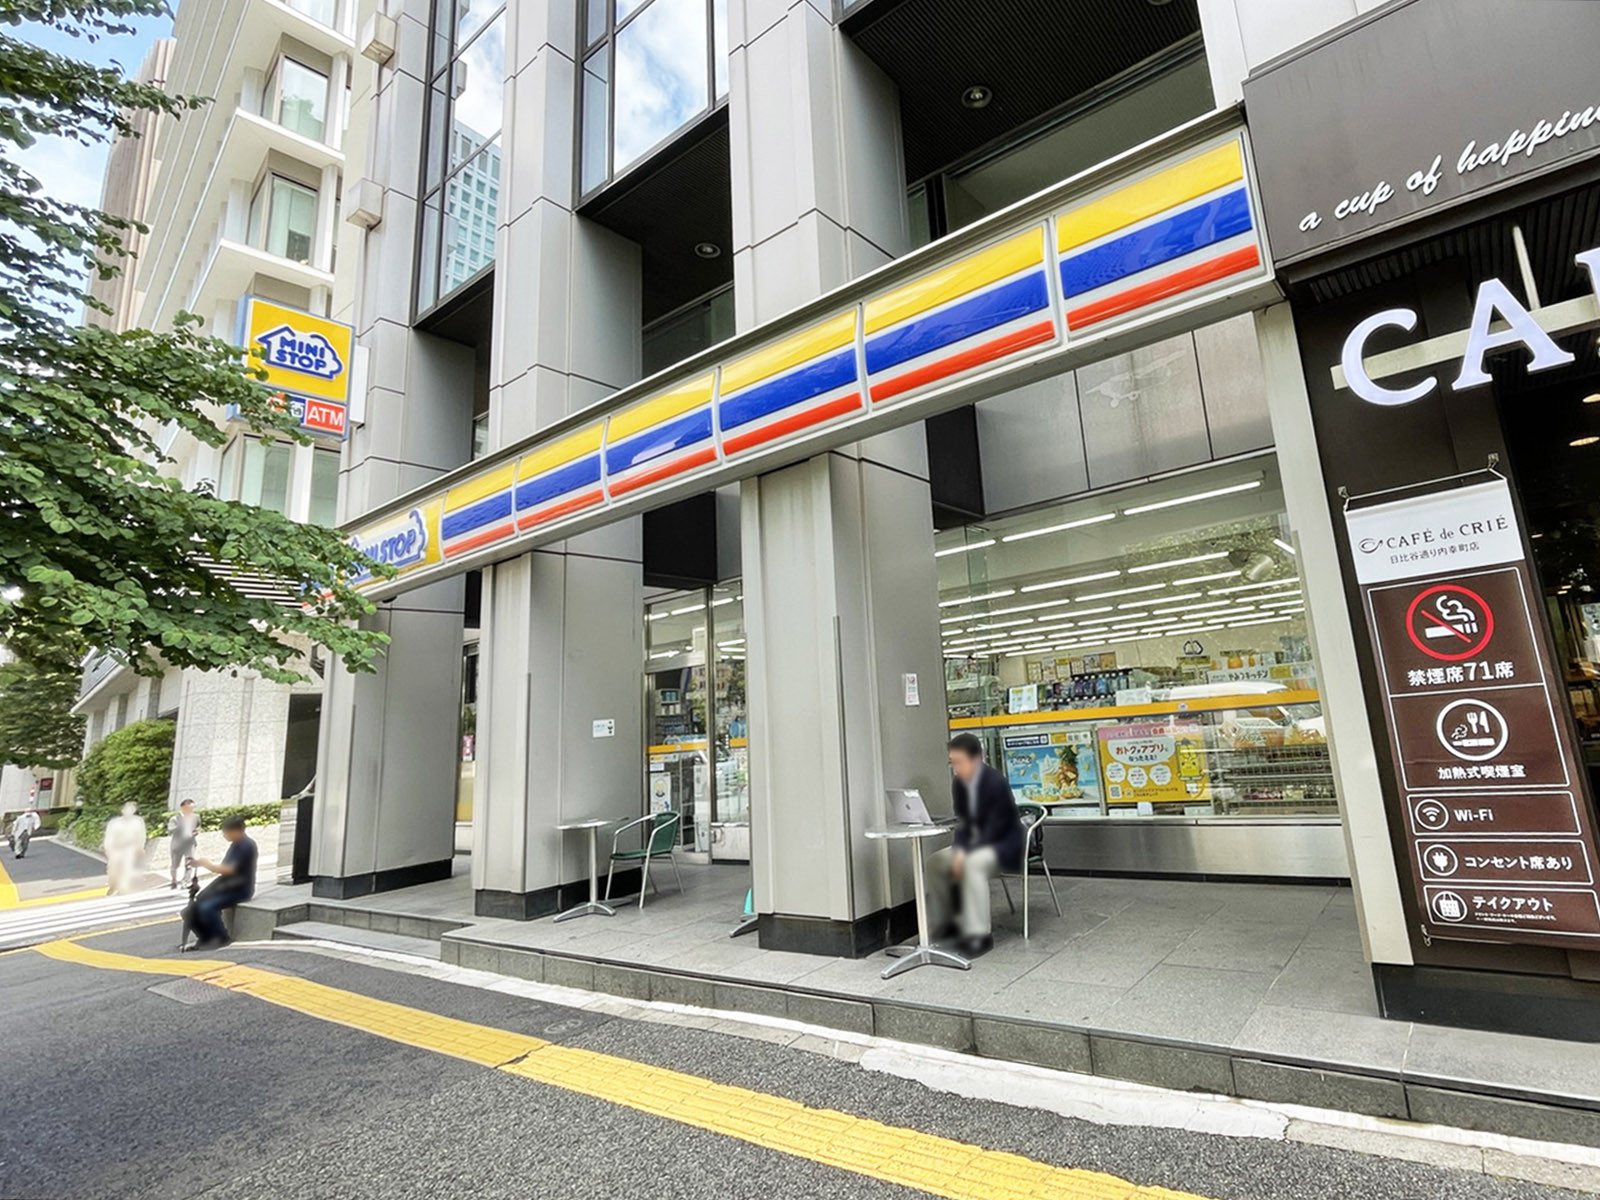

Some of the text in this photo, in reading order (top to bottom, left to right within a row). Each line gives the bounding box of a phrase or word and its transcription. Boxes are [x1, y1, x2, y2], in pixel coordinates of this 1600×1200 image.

[1298, 213, 1322, 232] a
[1334, 180, 1395, 220] cup
[1406, 154, 1443, 196] of
[279, 336, 326, 358] MINI
[275, 349, 327, 371] STOP
[307, 406, 344, 426] ATM
[1385, 515, 1509, 550] CAFÉ de CRIÉ
[380, 528, 416, 563] STOP
[1389, 541, 1480, 565] 日比谷通り内幸町店
[1407, 660, 1515, 687] 禁煙席71席
[1437, 765, 1527, 780] 加熱式喫煙室
[1453, 808, 1495, 823] Wi-Fi
[1464, 855, 1573, 871] コンセント席あり
[1472, 896, 1554, 912] テイクアウト
